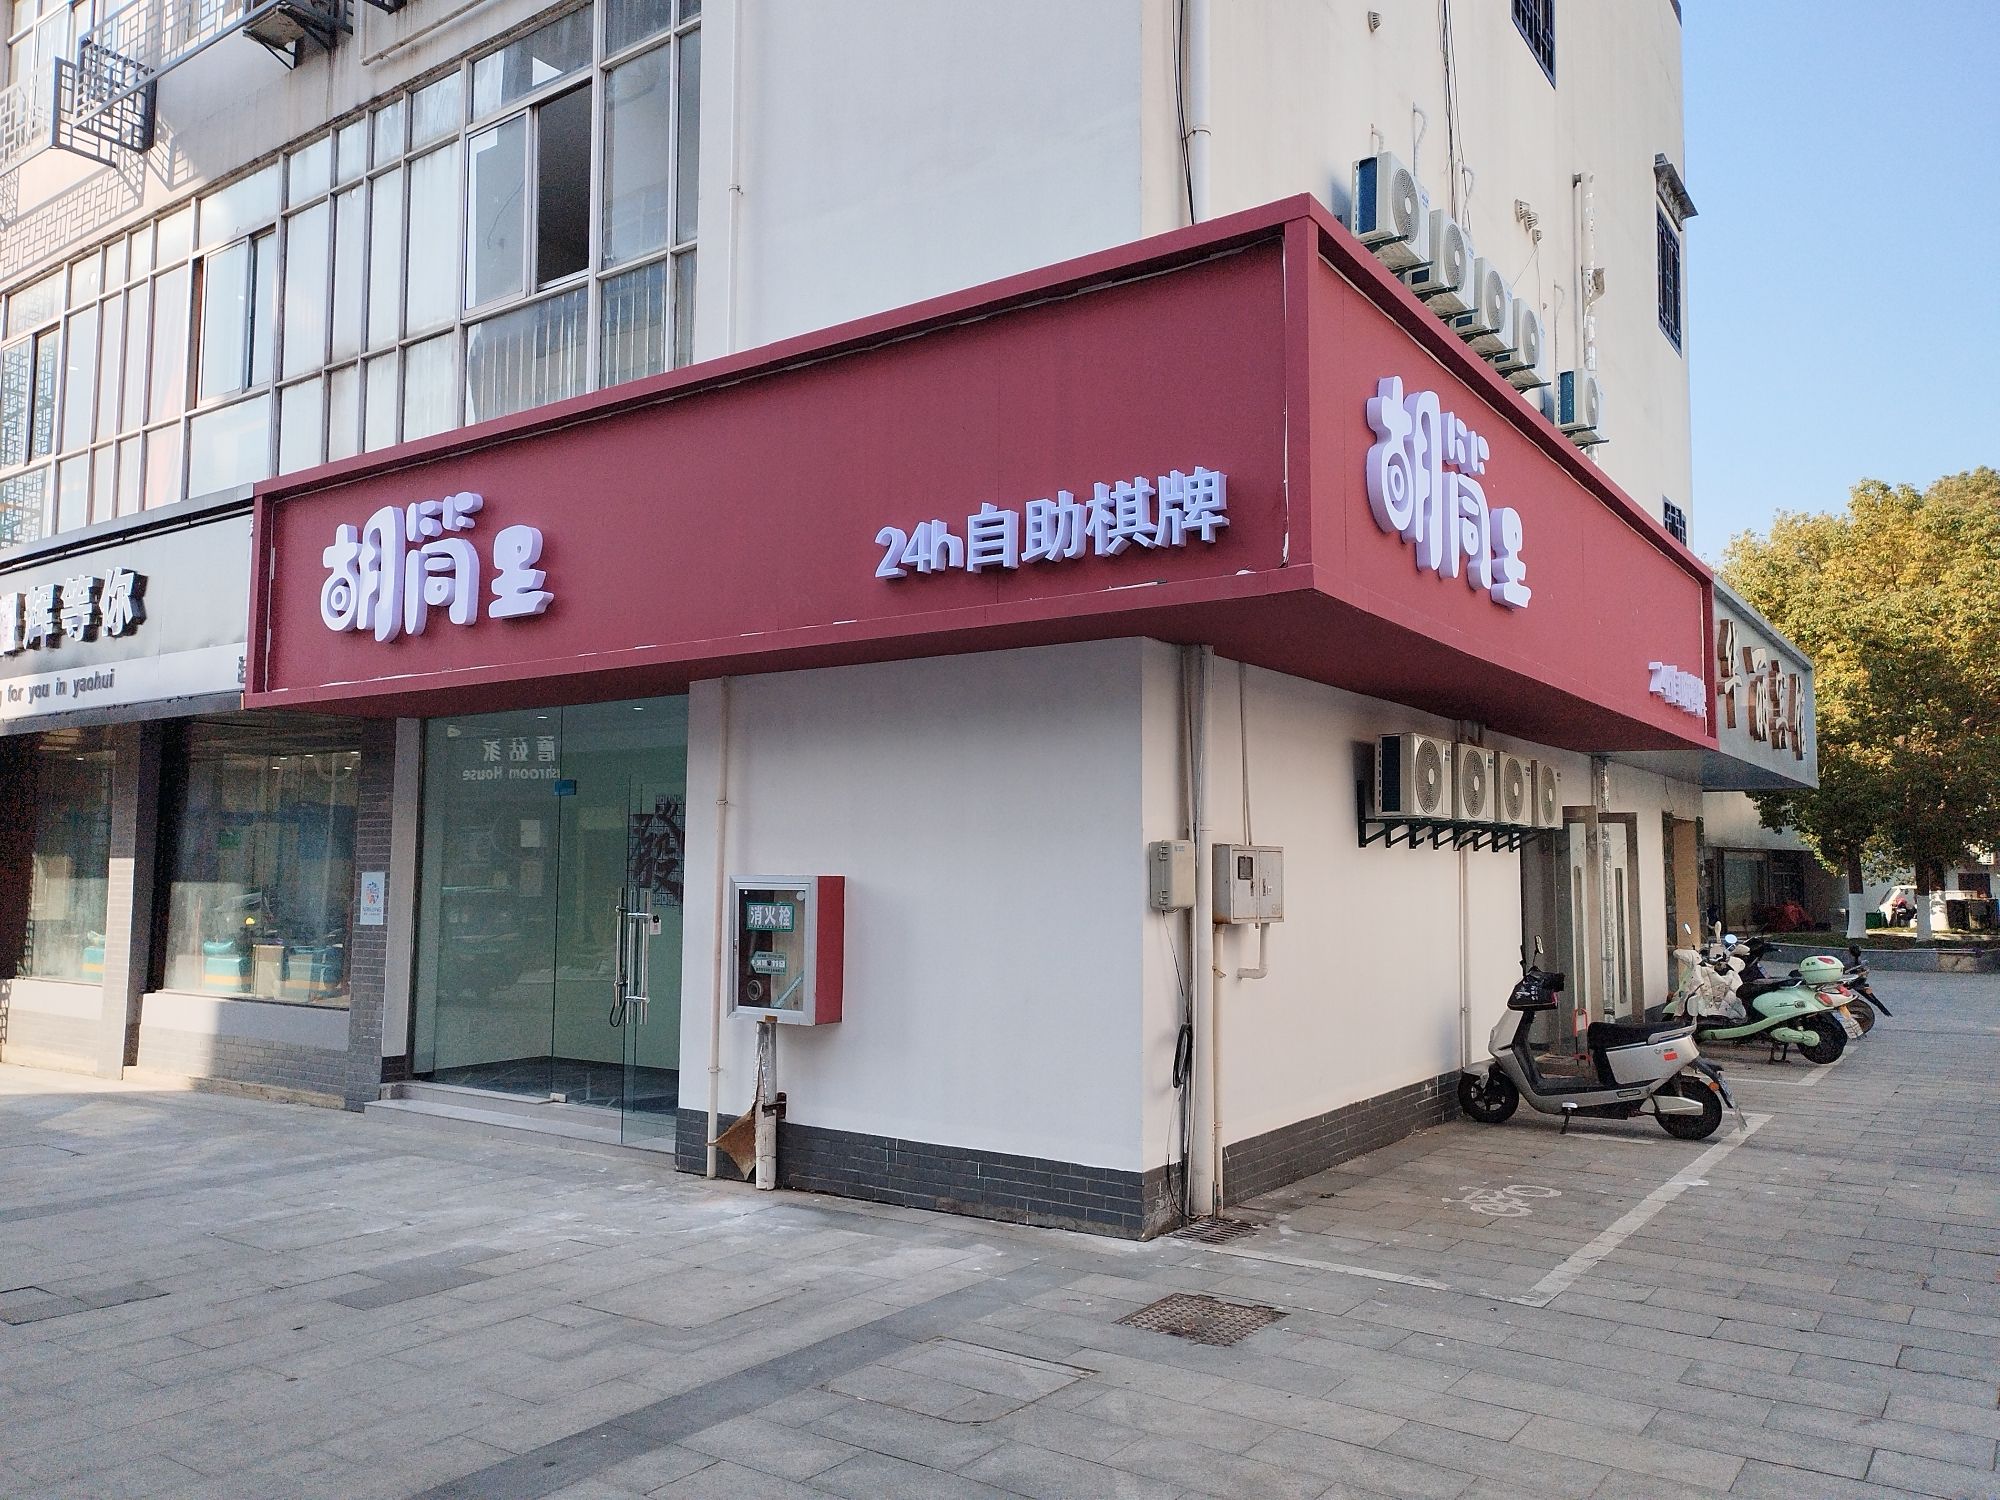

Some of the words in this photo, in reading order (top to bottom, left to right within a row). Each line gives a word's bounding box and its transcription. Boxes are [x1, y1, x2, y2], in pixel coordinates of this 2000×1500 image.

[875, 466, 1230, 579] 24h自助棋牌
[7, 684, 24, 702] for
[28, 683, 50, 704] you
[55, 677, 68, 696] in
[750, 905, 791, 926] 消火栓
